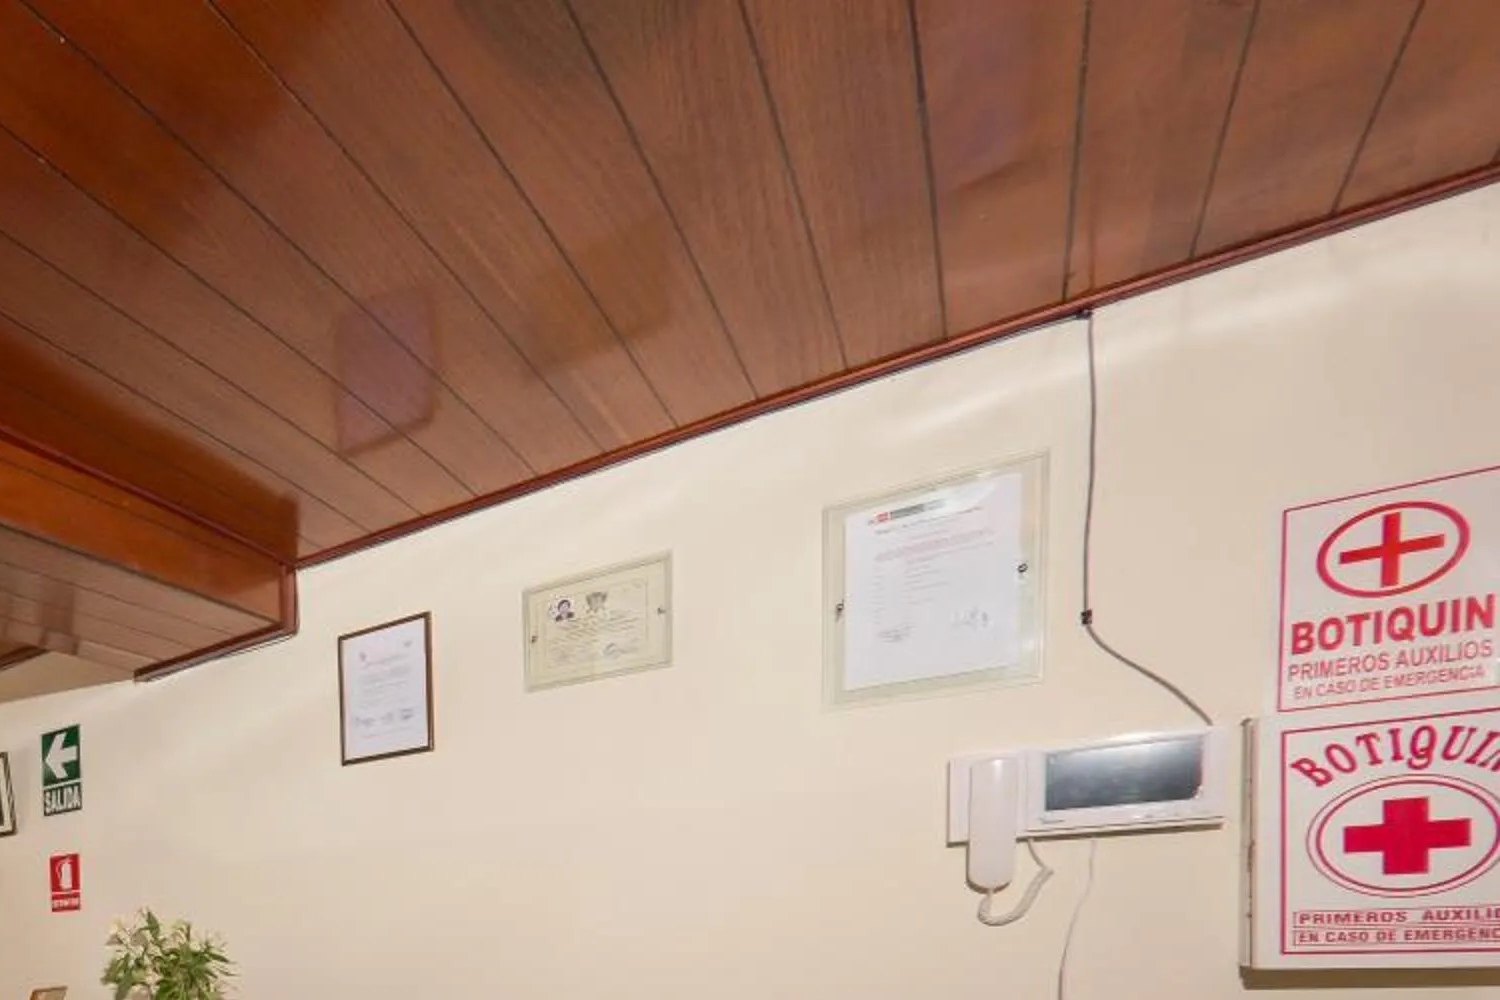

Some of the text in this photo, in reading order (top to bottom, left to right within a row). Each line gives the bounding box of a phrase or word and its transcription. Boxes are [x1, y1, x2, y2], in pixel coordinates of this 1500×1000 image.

[1291, 593, 1495, 655] BOTIQUIN
[1288, 639, 1492, 682] PRIMEROS AUXILIOS
[1295, 685, 1313, 699] EN
[1316, 680, 1357, 696] CASO
[1360, 677, 1380, 692] DE
[45, 786, 80, 814] SALIDA
[1300, 911, 1408, 924] PRIMEROS
[1300, 930, 1319, 942] EN
[1325, 930, 1369, 942] CASO
[1376, 929, 1395, 942] DE
